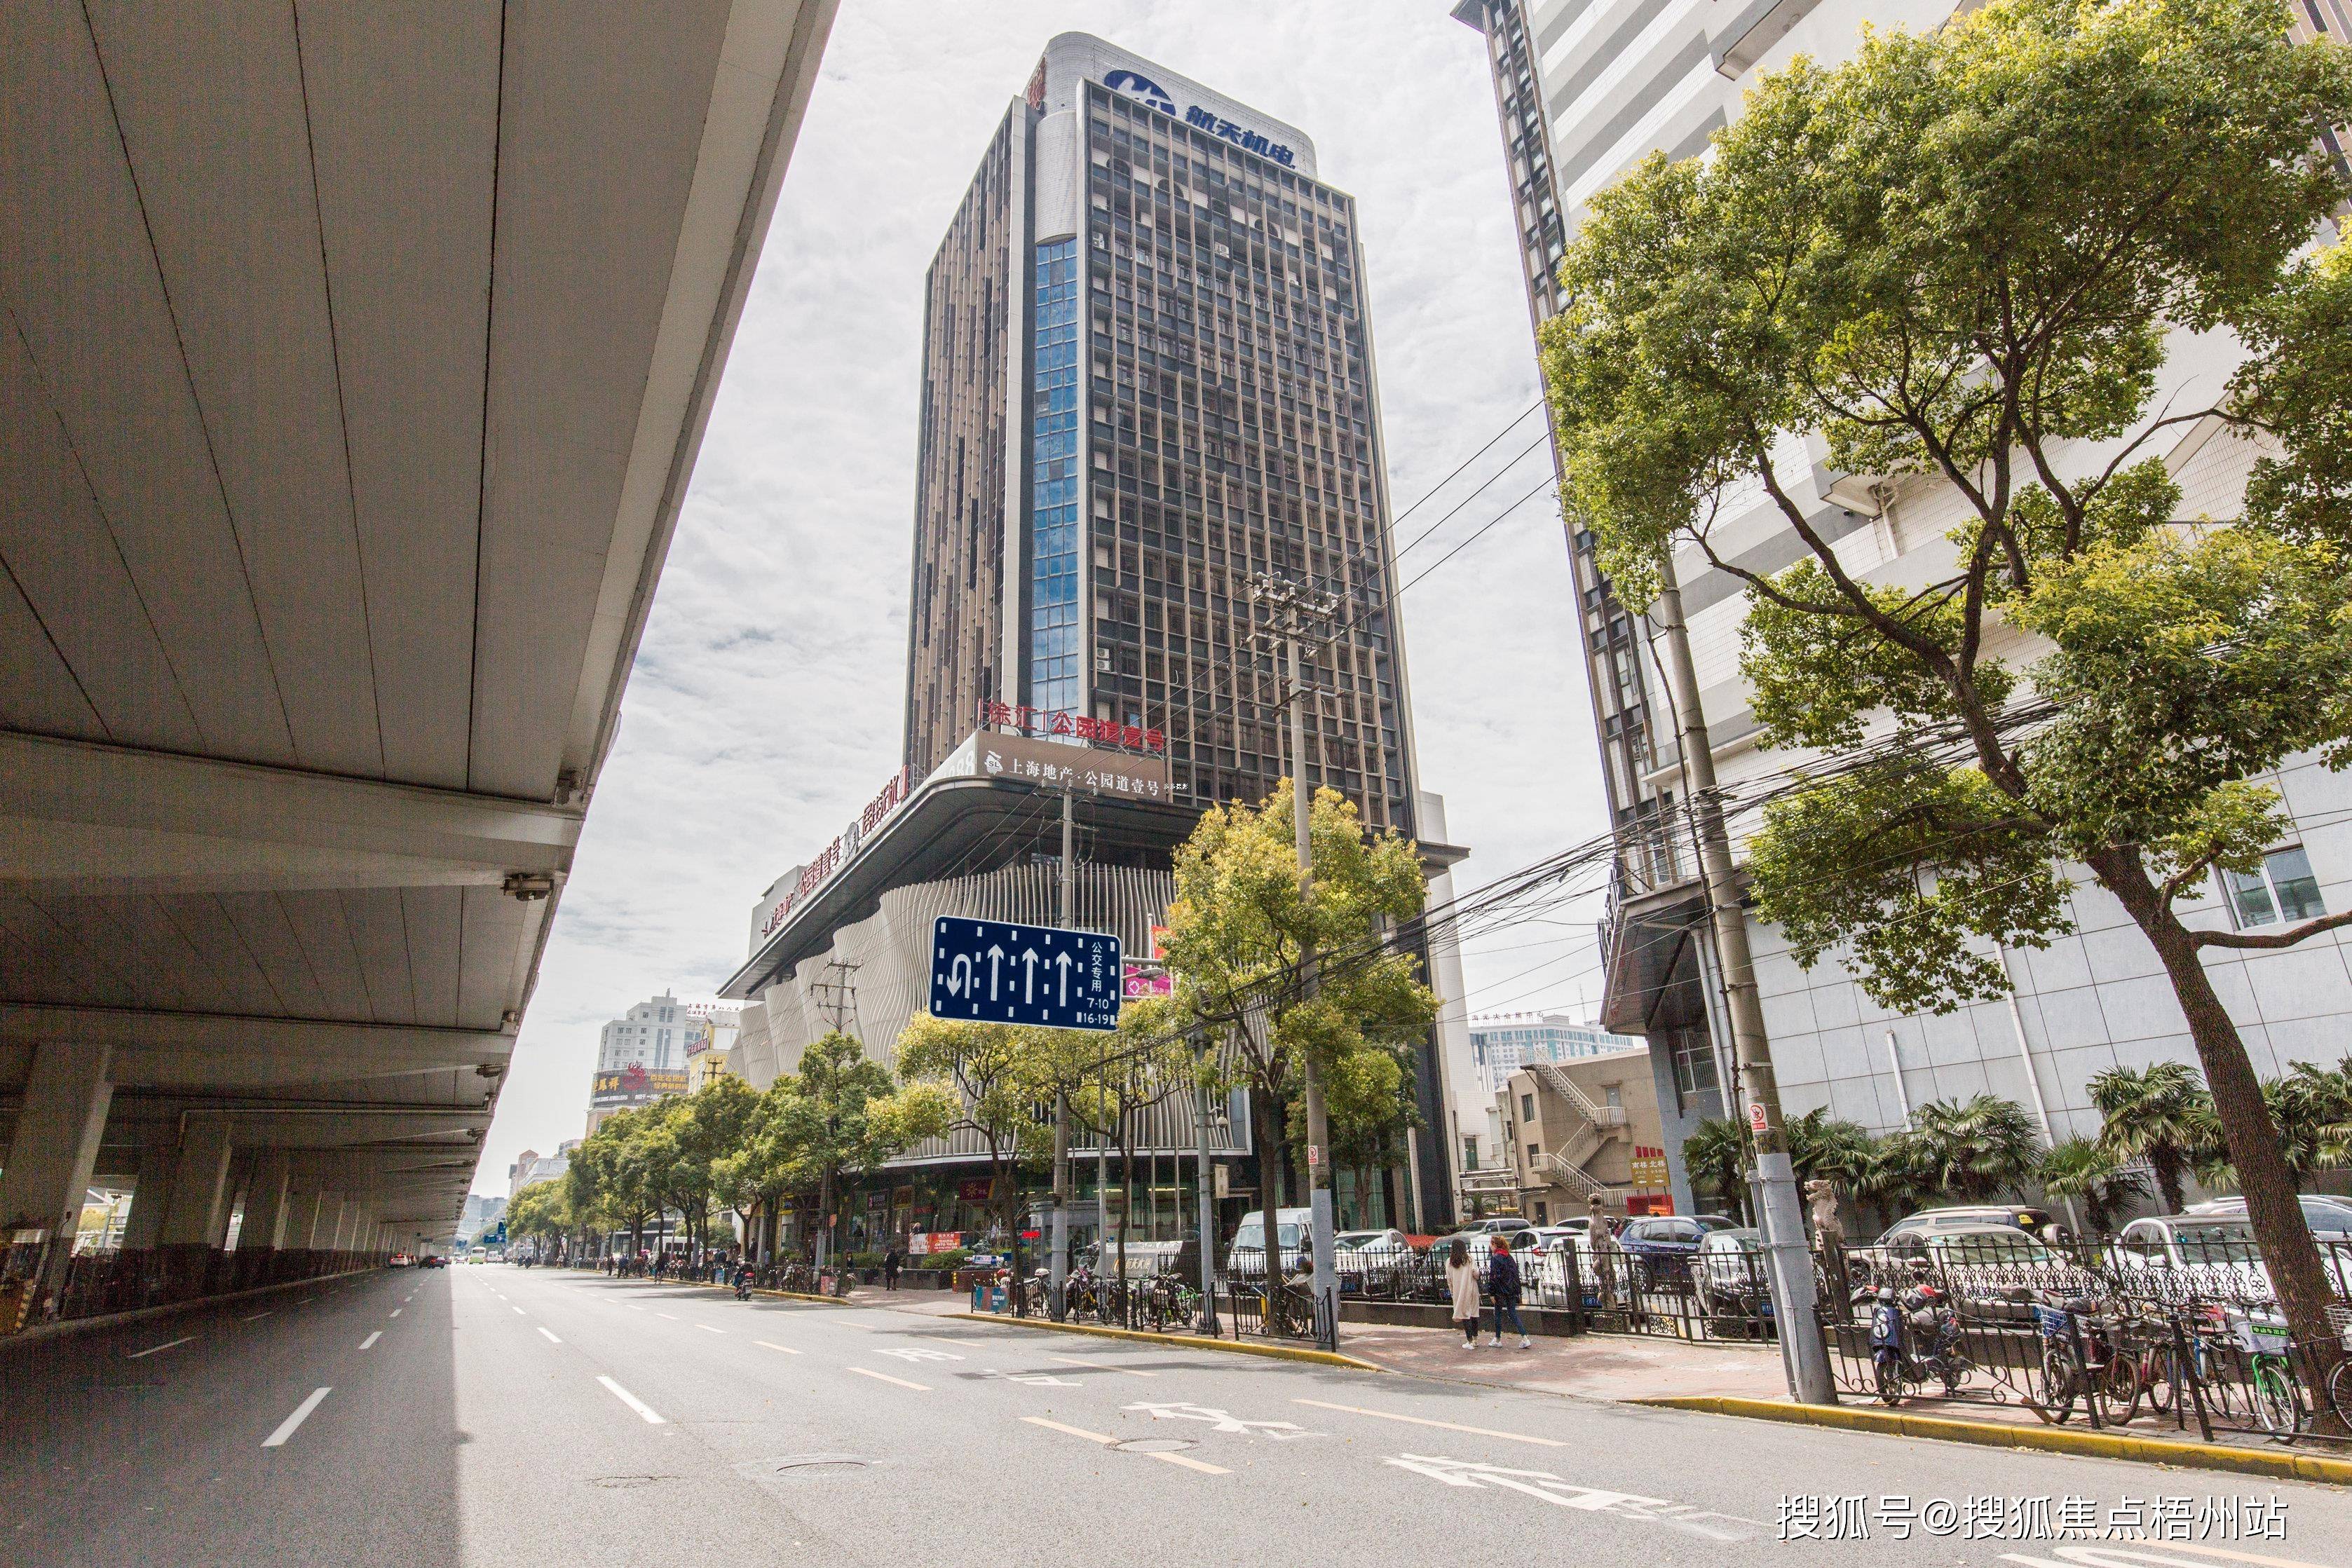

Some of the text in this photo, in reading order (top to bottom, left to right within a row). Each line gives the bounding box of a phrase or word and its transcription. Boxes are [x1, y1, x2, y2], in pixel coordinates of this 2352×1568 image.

[1185, 104, 1296, 170] 航天机电
[1091, 941, 1103, 993] 公交专用
[1083, 1012, 1109, 1025] 16-19
[1087, 997, 1109, 1010] 7-10
